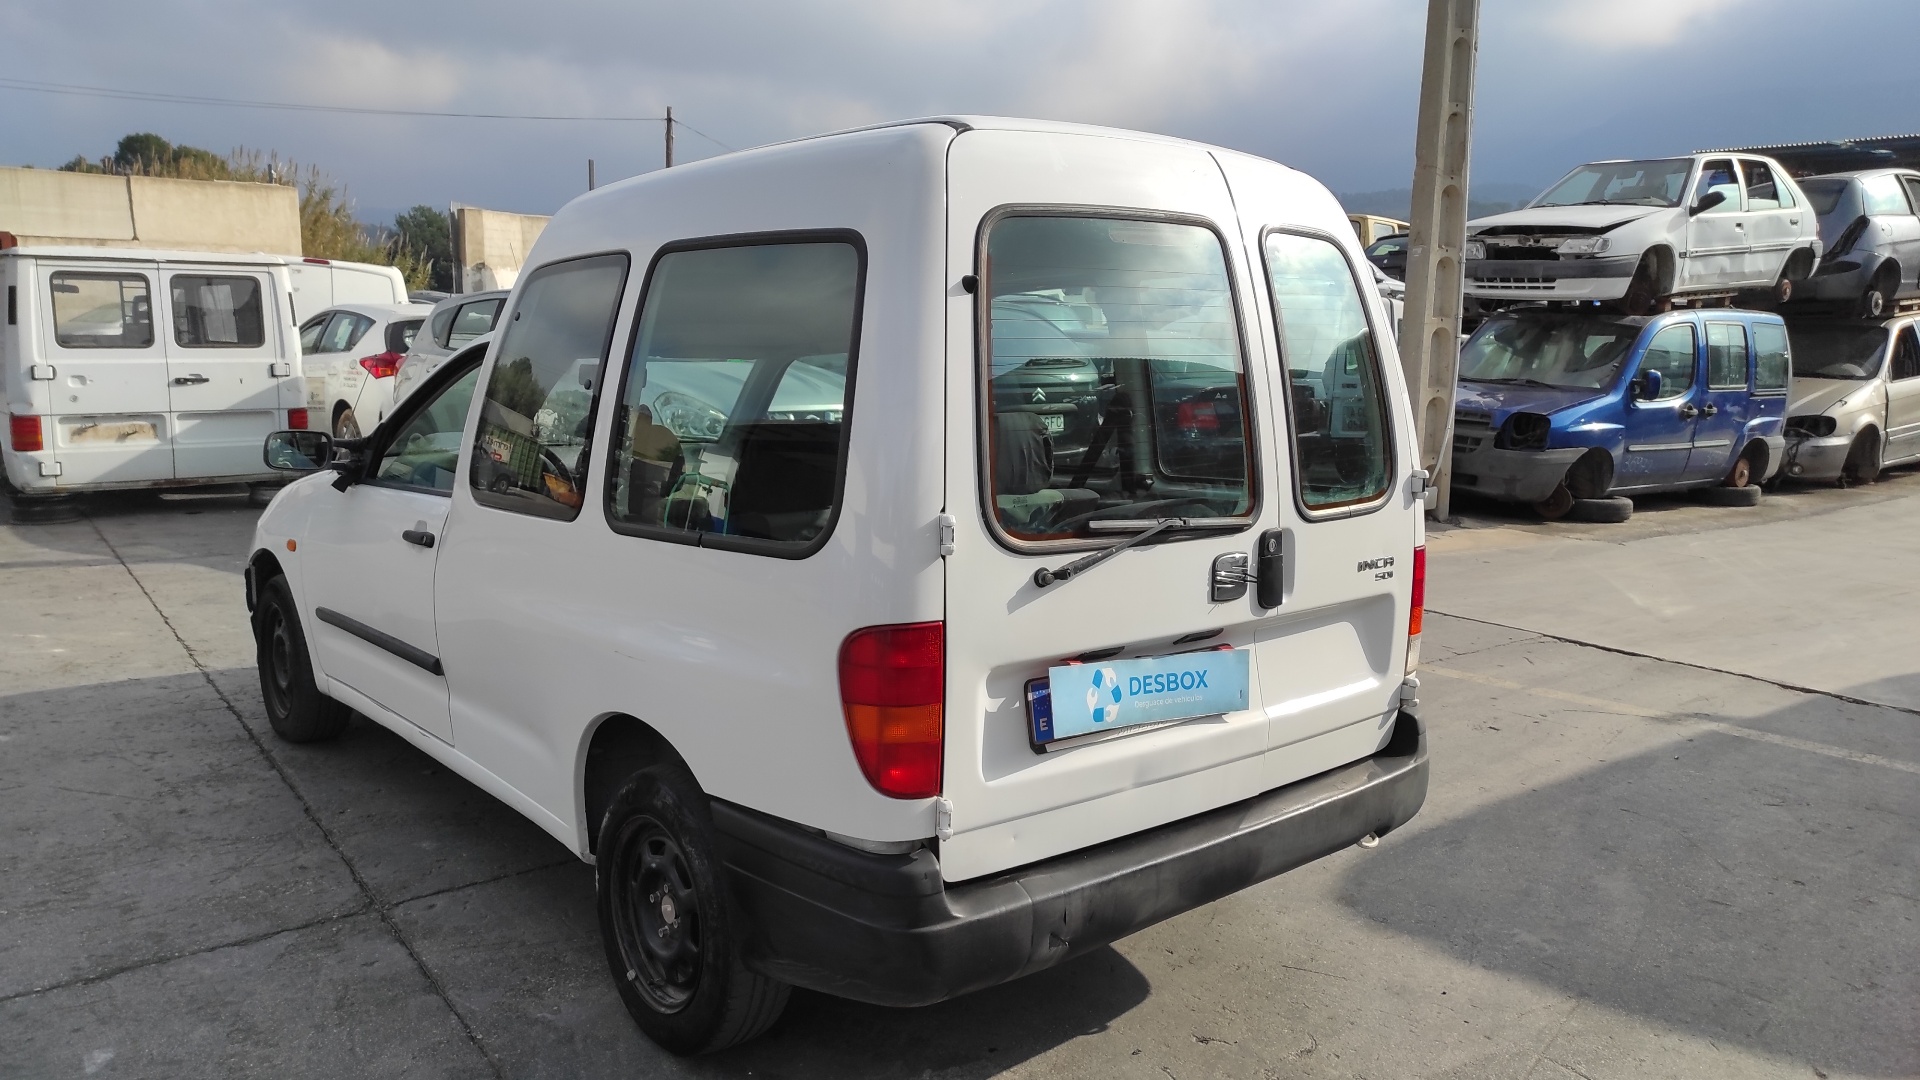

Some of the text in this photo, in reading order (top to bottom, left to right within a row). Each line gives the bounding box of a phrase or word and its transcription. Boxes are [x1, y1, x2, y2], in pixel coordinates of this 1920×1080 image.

[1357, 556, 1395, 573] INCA
[1129, 669, 1209, 697] DESBOX
[1134, 698, 1164, 710] Desguace
[1164, 697, 1173, 706] de
[1039, 717, 1049, 732] E
